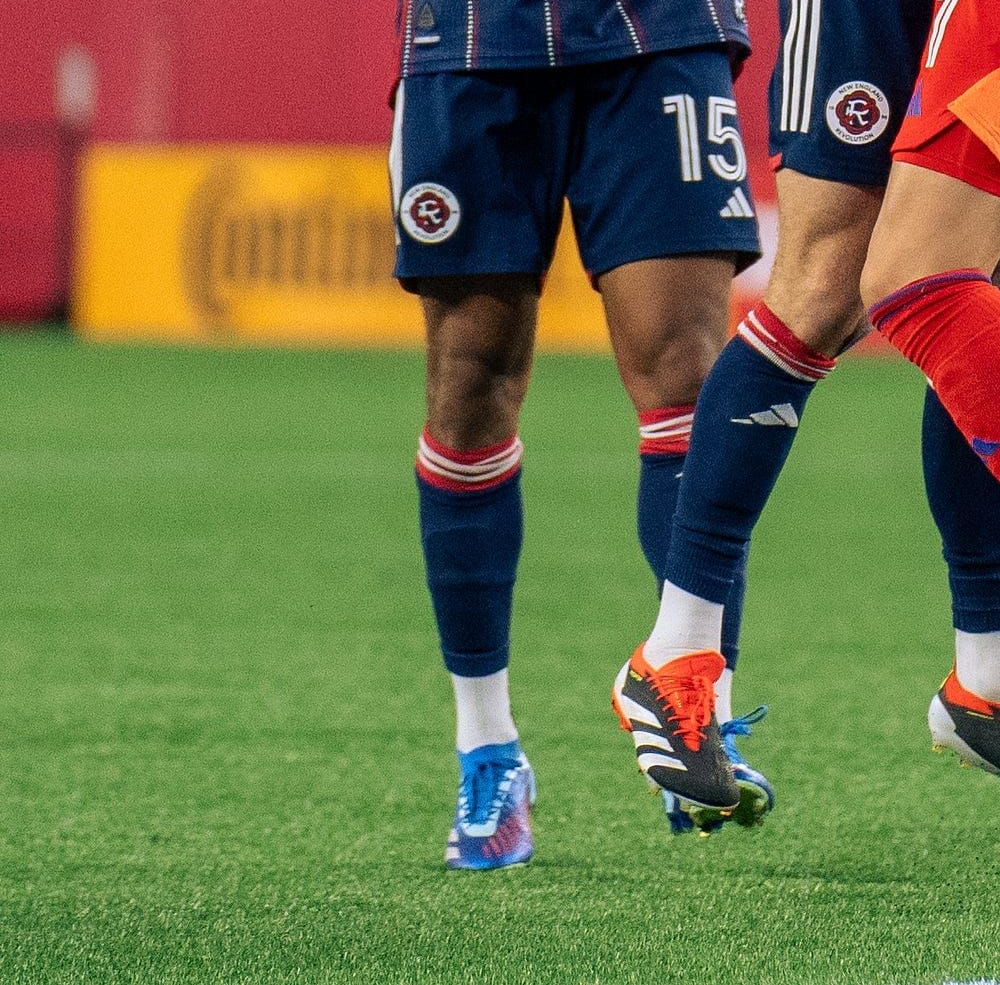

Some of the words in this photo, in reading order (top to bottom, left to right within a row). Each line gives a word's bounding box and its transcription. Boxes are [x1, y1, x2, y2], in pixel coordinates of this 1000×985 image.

[838, 83, 853, 94] NEW
[854, 83, 884, 103] ENGLAND
[663, 94, 748, 182] 15
